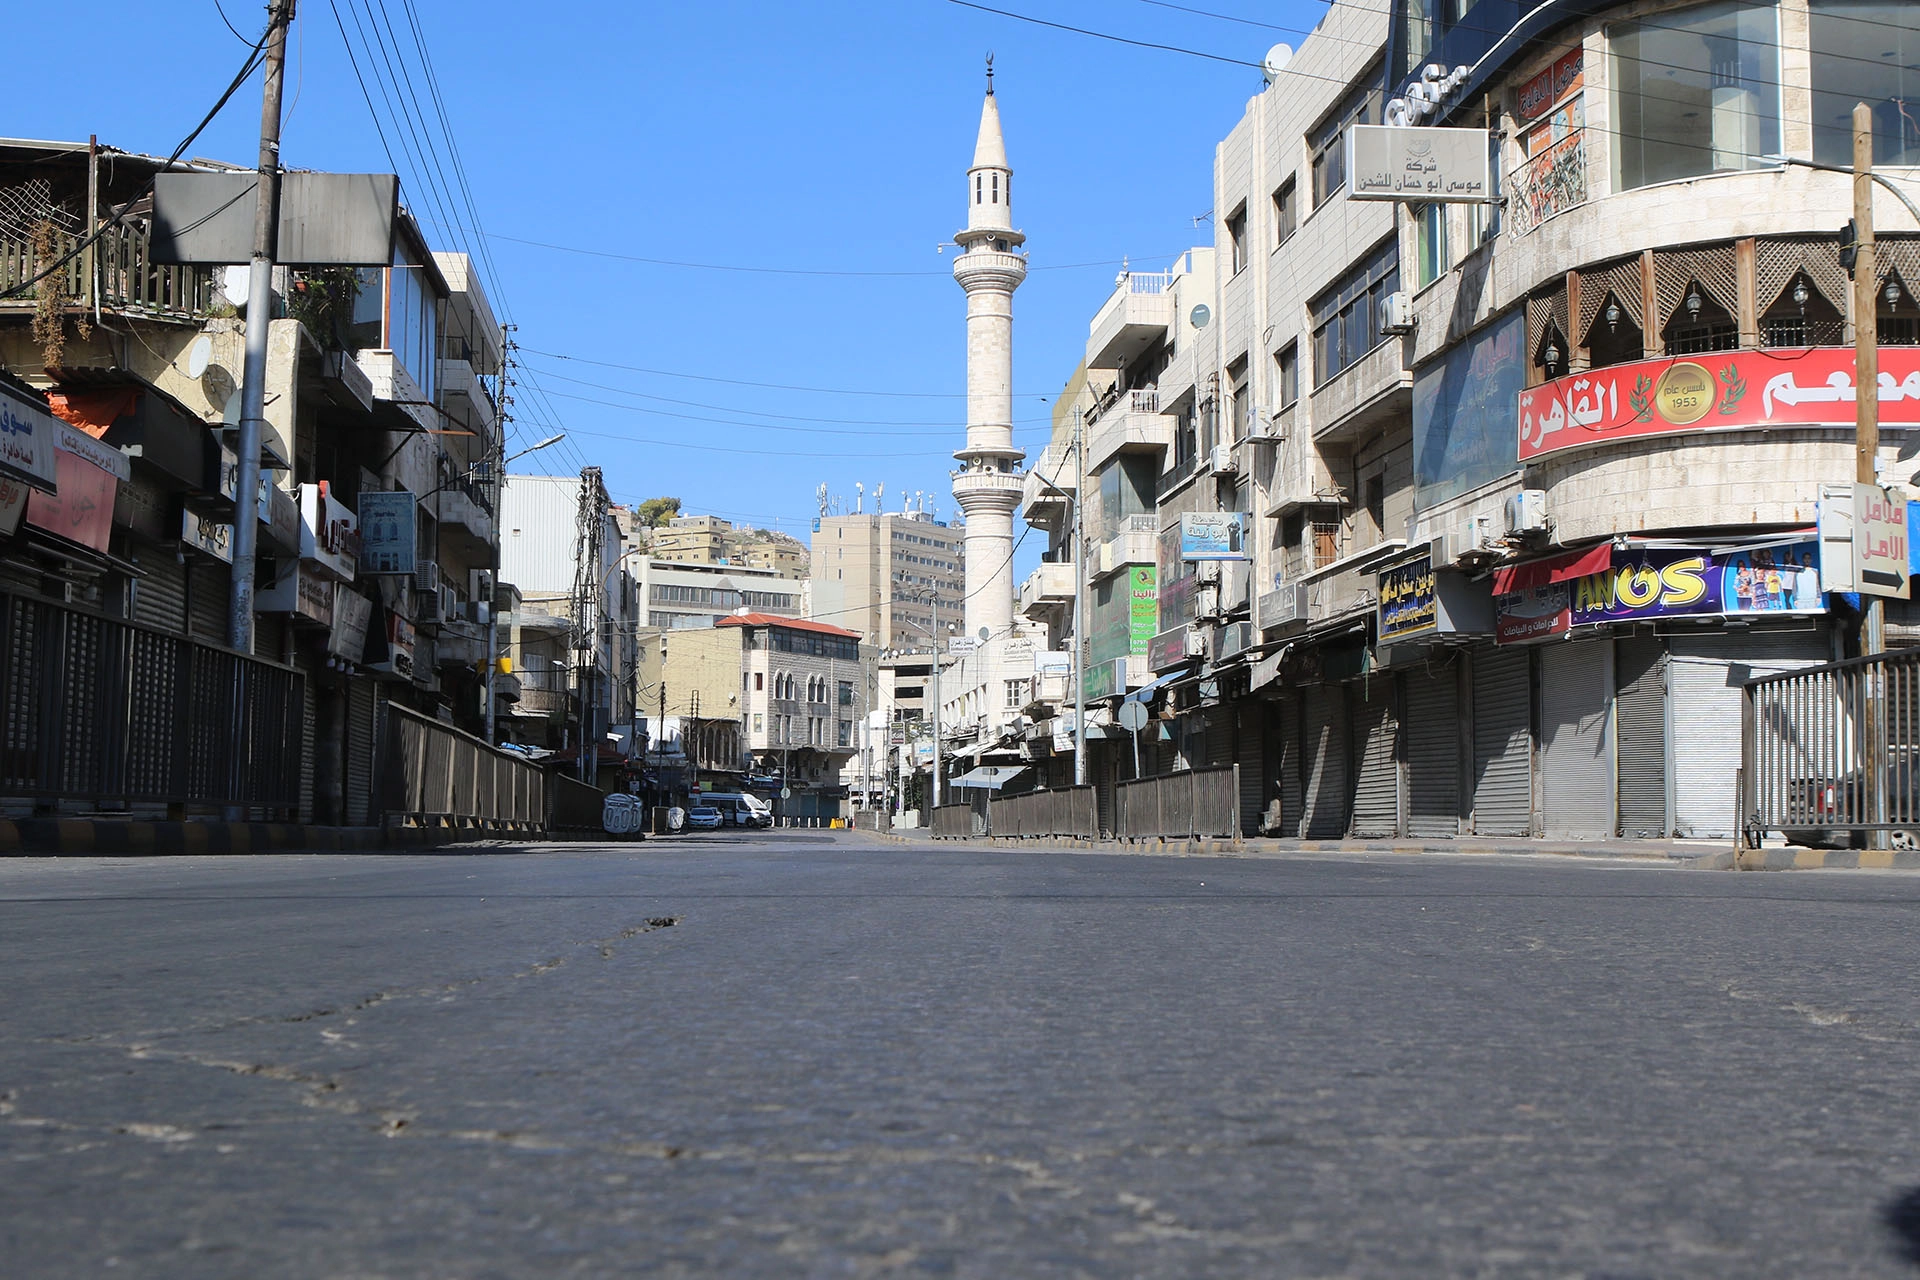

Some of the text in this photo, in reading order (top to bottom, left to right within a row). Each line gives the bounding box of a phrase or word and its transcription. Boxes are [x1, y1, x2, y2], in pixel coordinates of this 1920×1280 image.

[1405, 157, 1437, 174] شركة
[1359, 173, 1392, 190] للشحن
[1446, 180, 1482, 193] موسى
[1663, 384, 1680, 397] عام
[1672, 396, 1698, 409] 1953
[1520, 377, 1618, 449] القاهرة
[1861, 495, 1903, 525] فلافل
